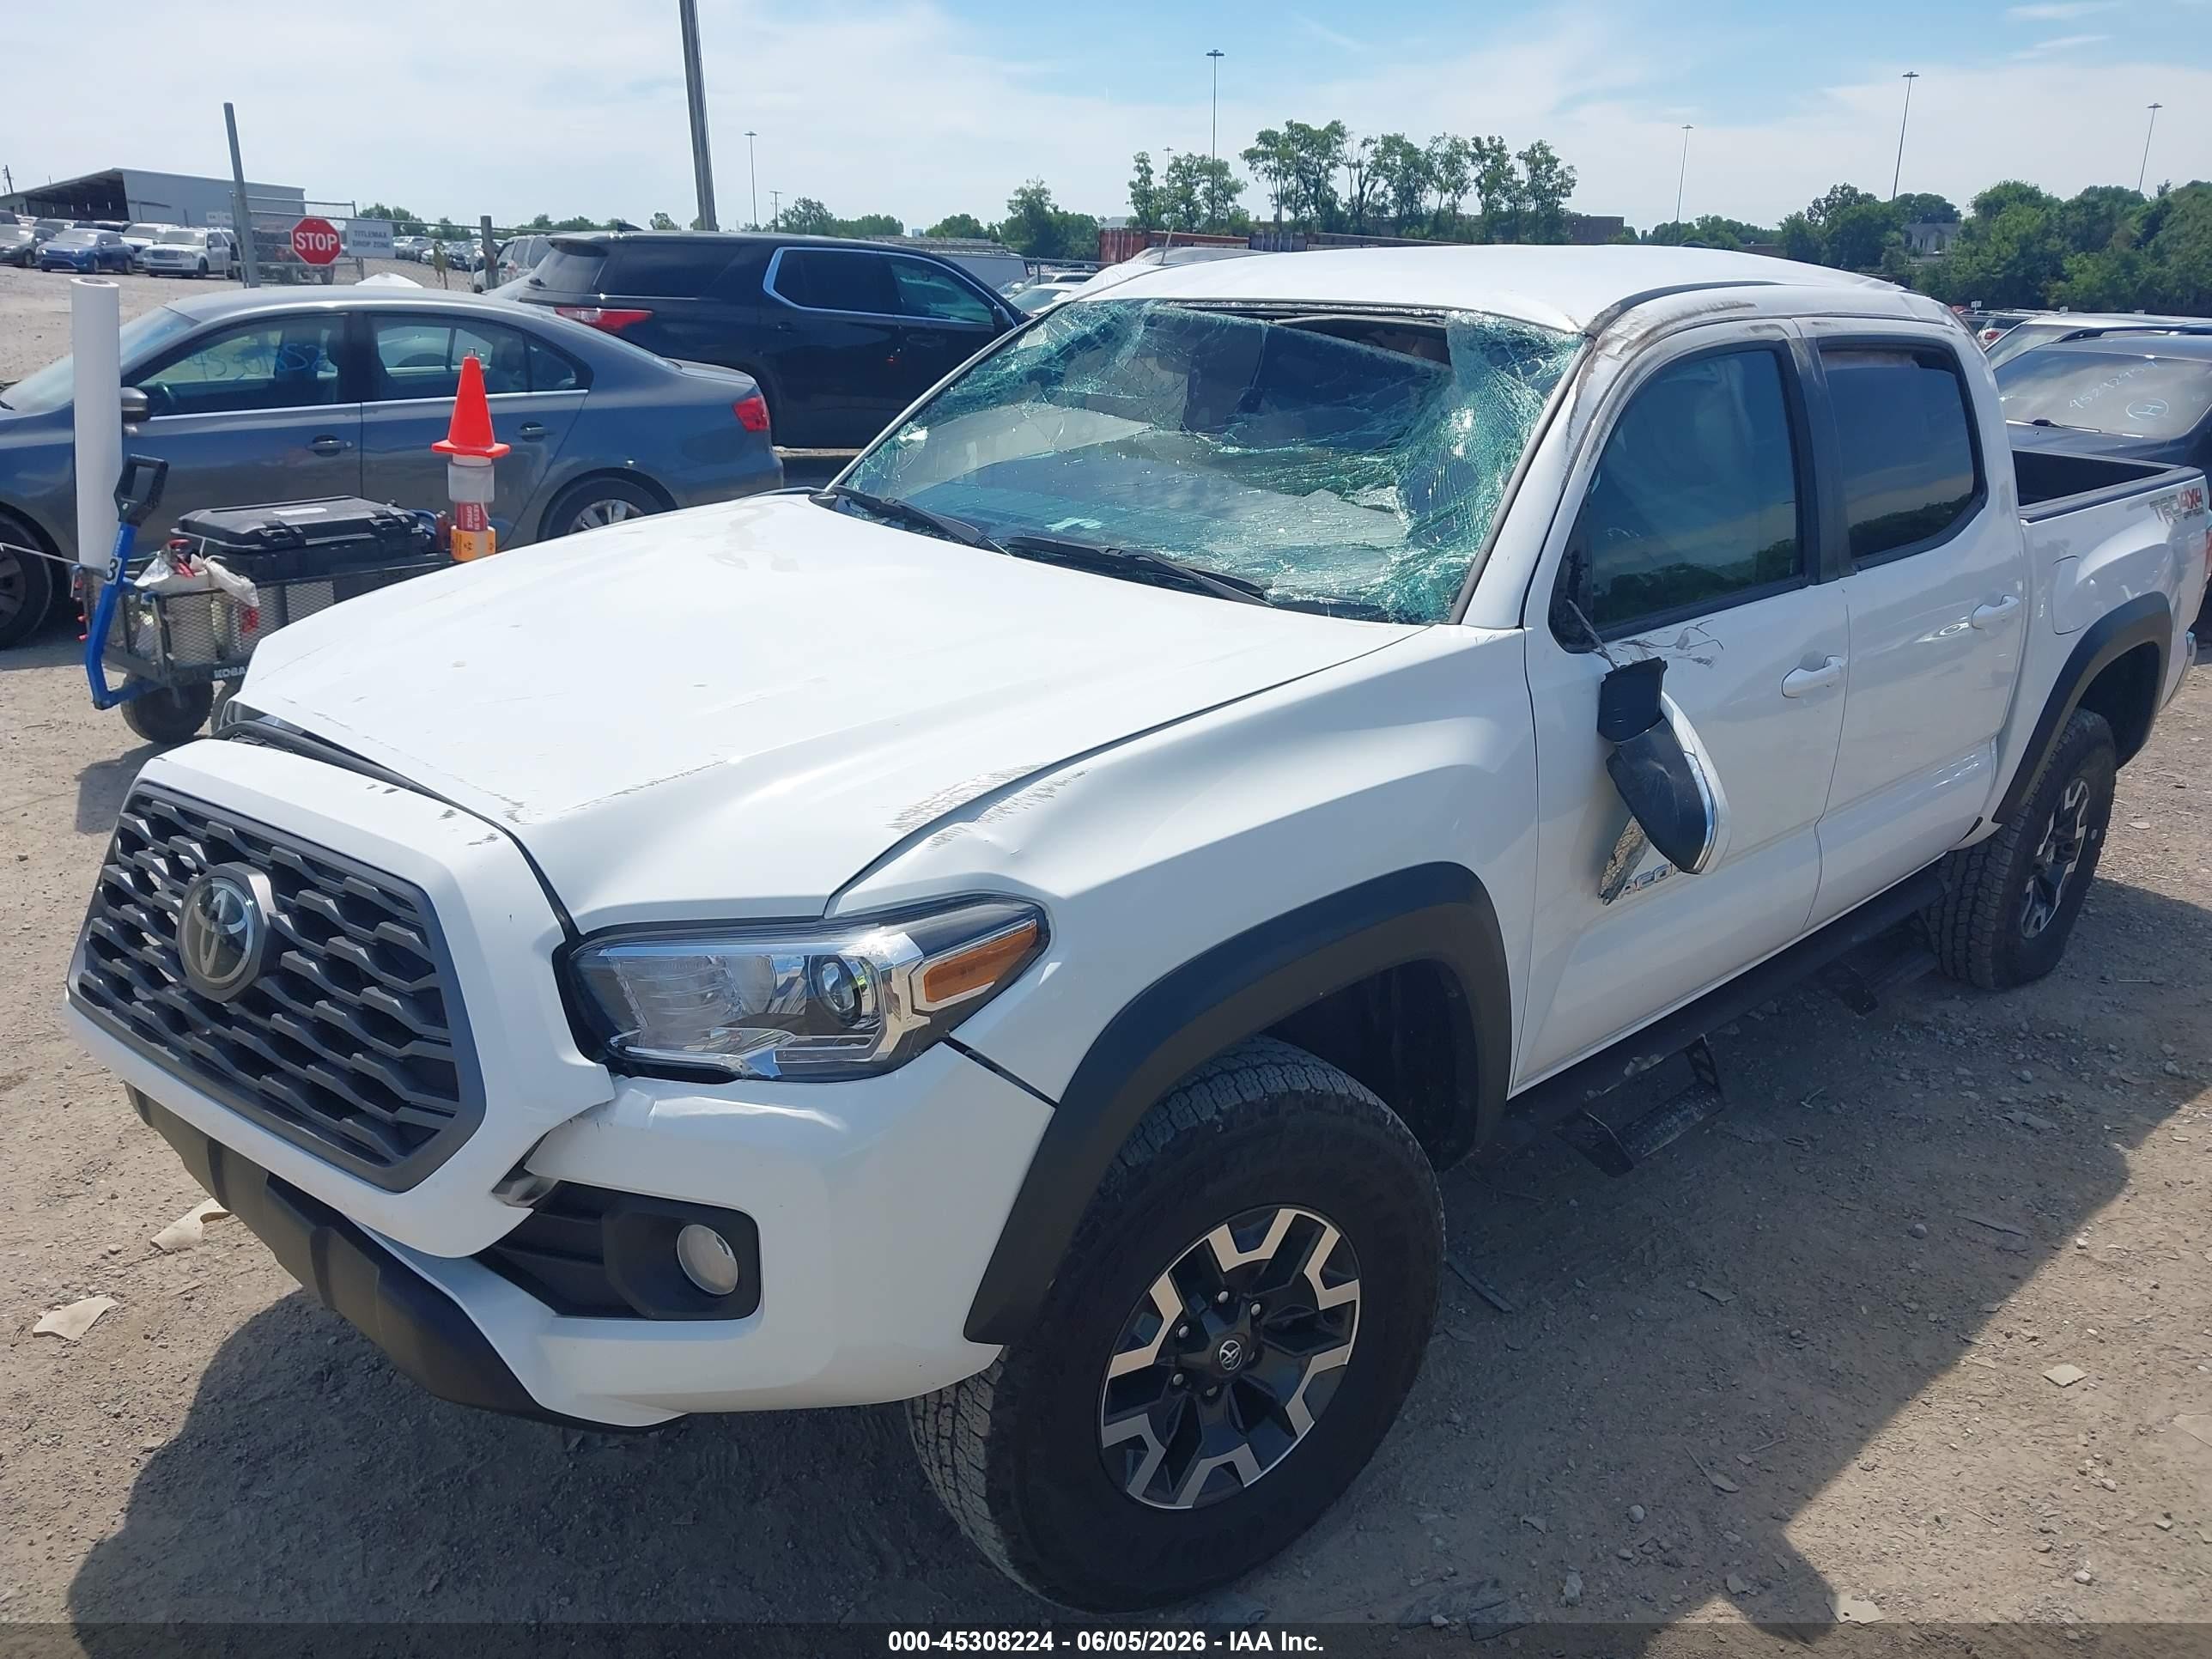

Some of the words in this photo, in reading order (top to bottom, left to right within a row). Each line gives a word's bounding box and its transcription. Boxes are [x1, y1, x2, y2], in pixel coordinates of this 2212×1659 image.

[295, 232, 338, 252] STOP
[354, 229, 388, 239] TITLEMAX
[2148, 495, 2181, 524] TRD
[106, 557, 119, 582] 3
[214, 665, 248, 679] KOBA
